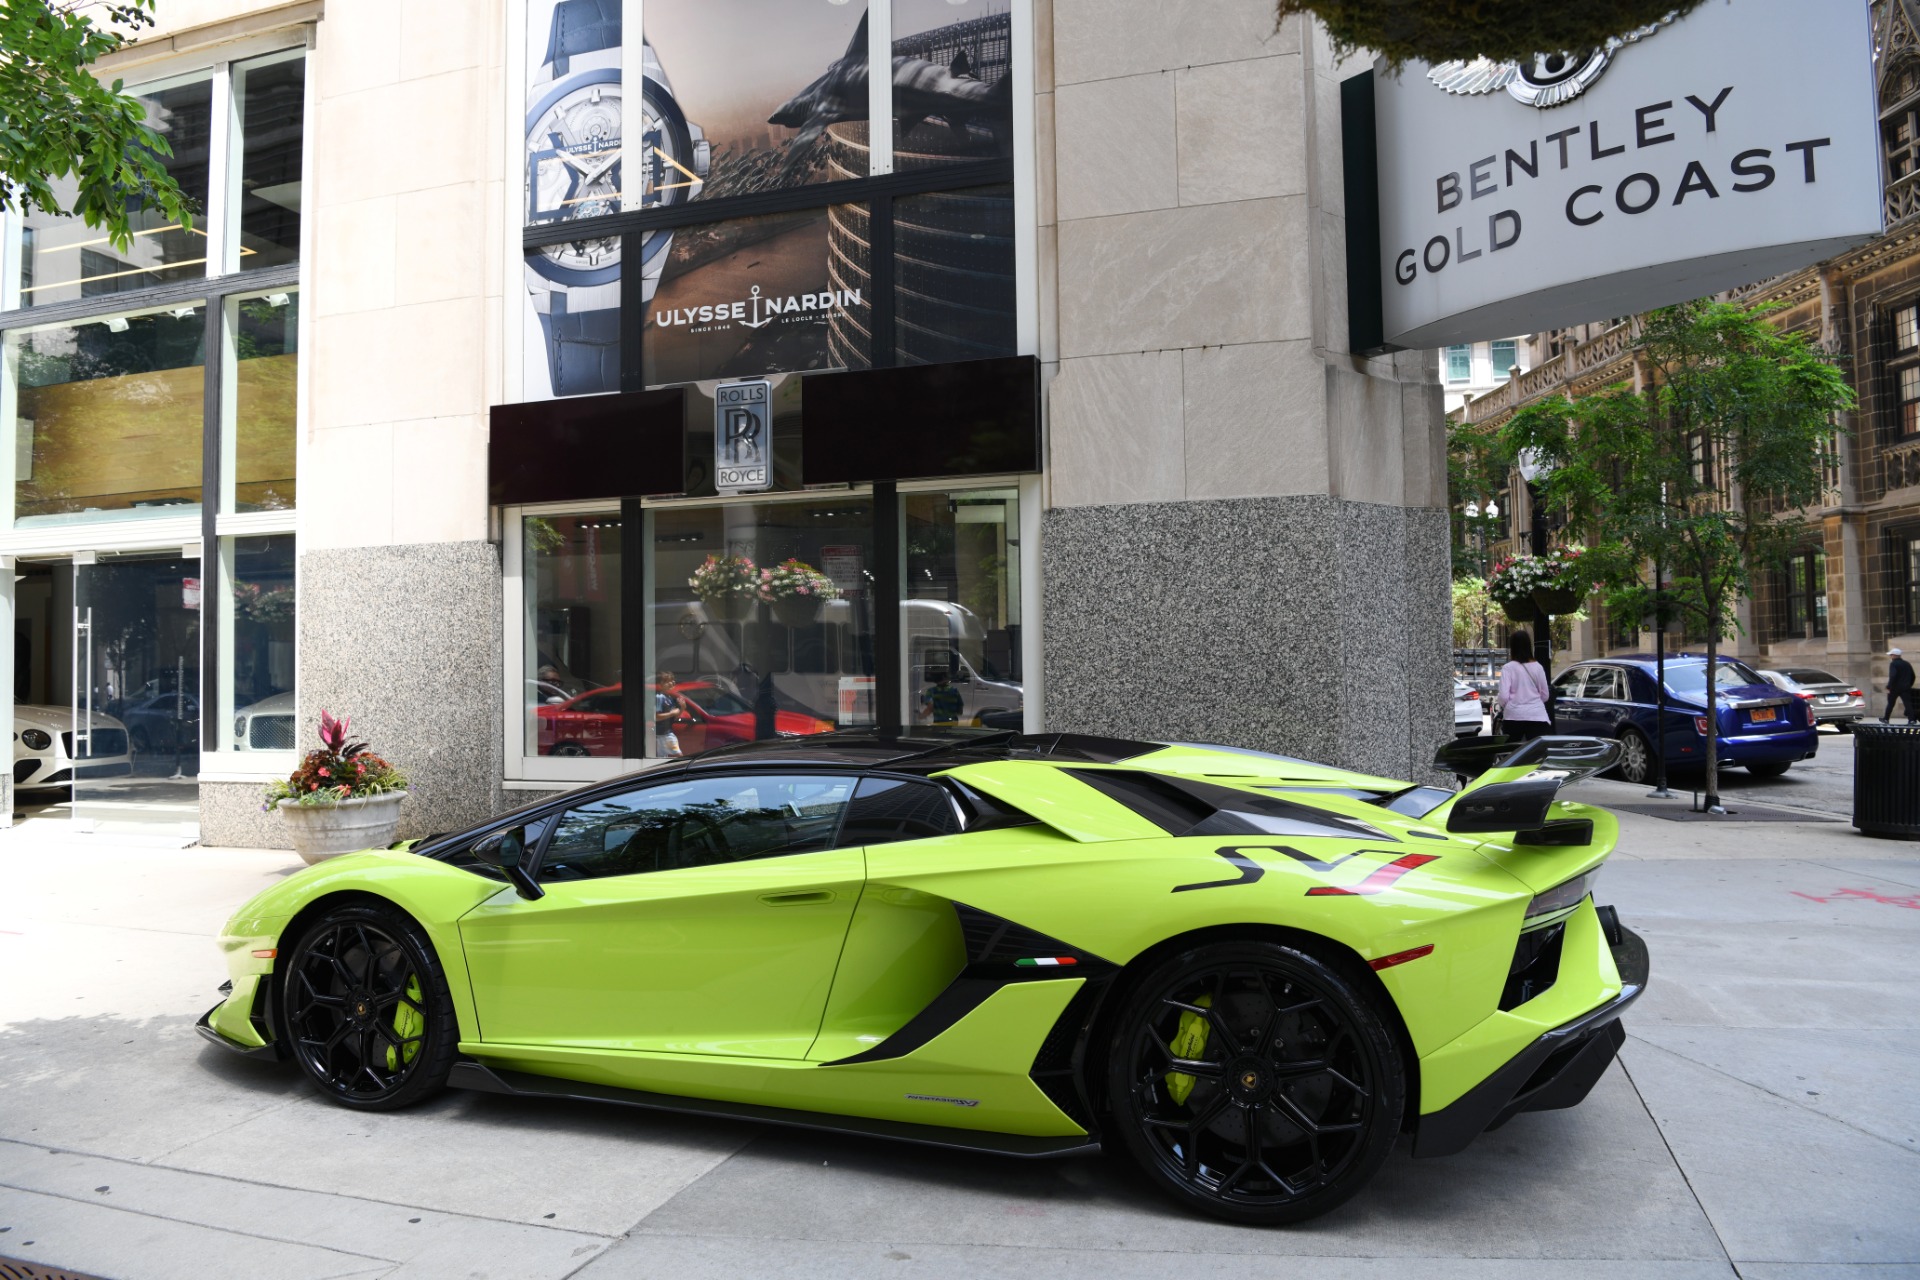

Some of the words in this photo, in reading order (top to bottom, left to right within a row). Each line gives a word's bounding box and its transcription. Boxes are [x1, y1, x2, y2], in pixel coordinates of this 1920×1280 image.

[1436, 86, 1734, 214] BENTLEY
[1394, 209, 1522, 286] GOLD
[1564, 137, 1831, 227] COAST
[656, 301, 746, 327] ULYSSE
[765, 288, 861, 315] NARDIN
[720, 387, 763, 403] ROLLS
[720, 469, 764, 484] ROYCE
